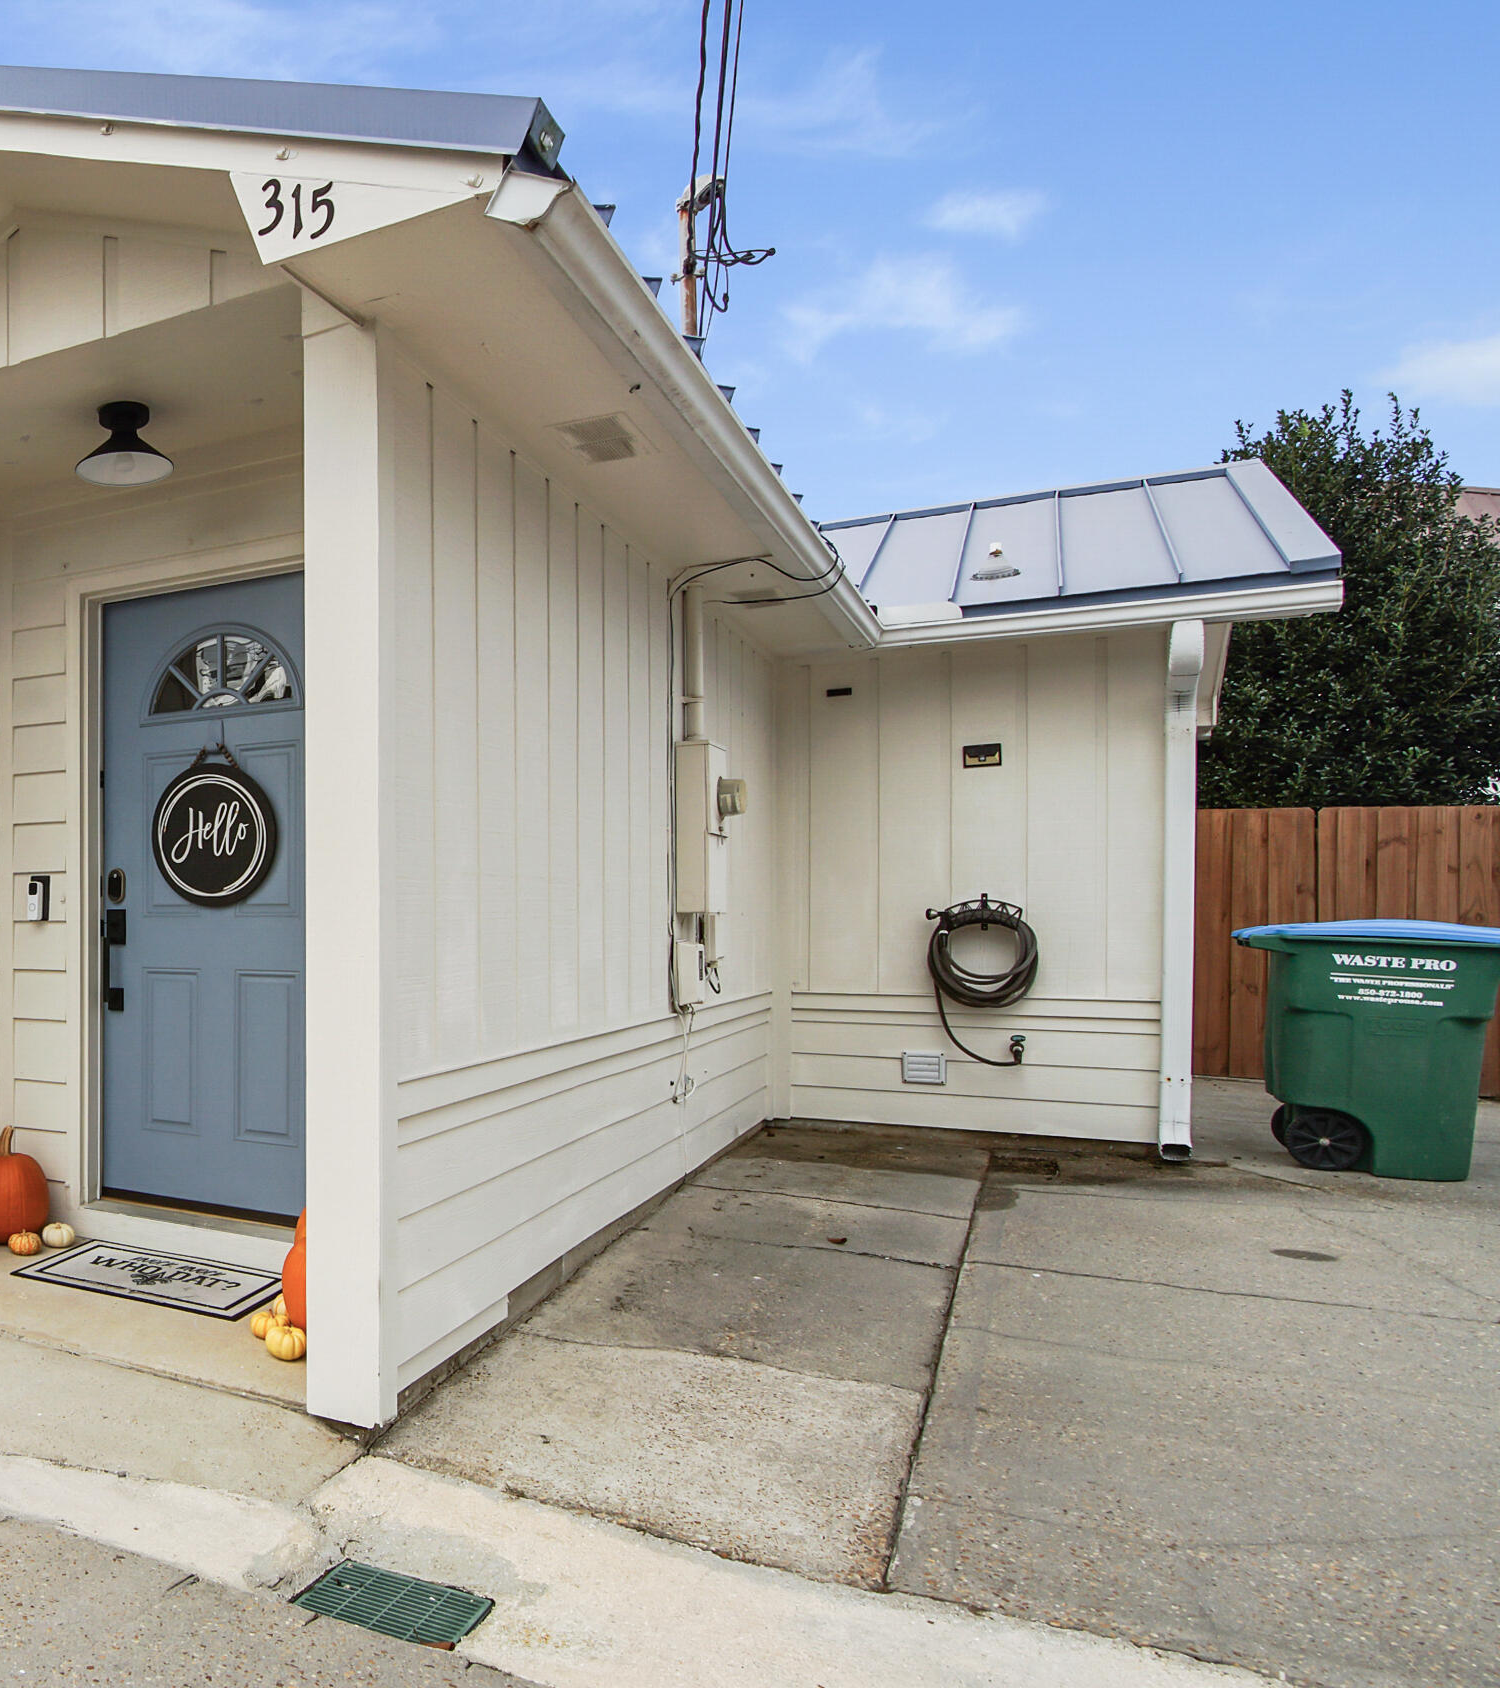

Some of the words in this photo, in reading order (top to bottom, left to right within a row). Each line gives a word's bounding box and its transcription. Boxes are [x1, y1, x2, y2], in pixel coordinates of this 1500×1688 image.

[257, 178, 335, 240] 315
[171, 801, 250, 864] Hello
[1332, 953, 1406, 969] WASTE
[1409, 957, 1458, 972] PRO
[1352, 978, 1382, 986] WASTE
[90, 1255, 163, 1276] WHO
[167, 1270, 242, 1291] DAT?
